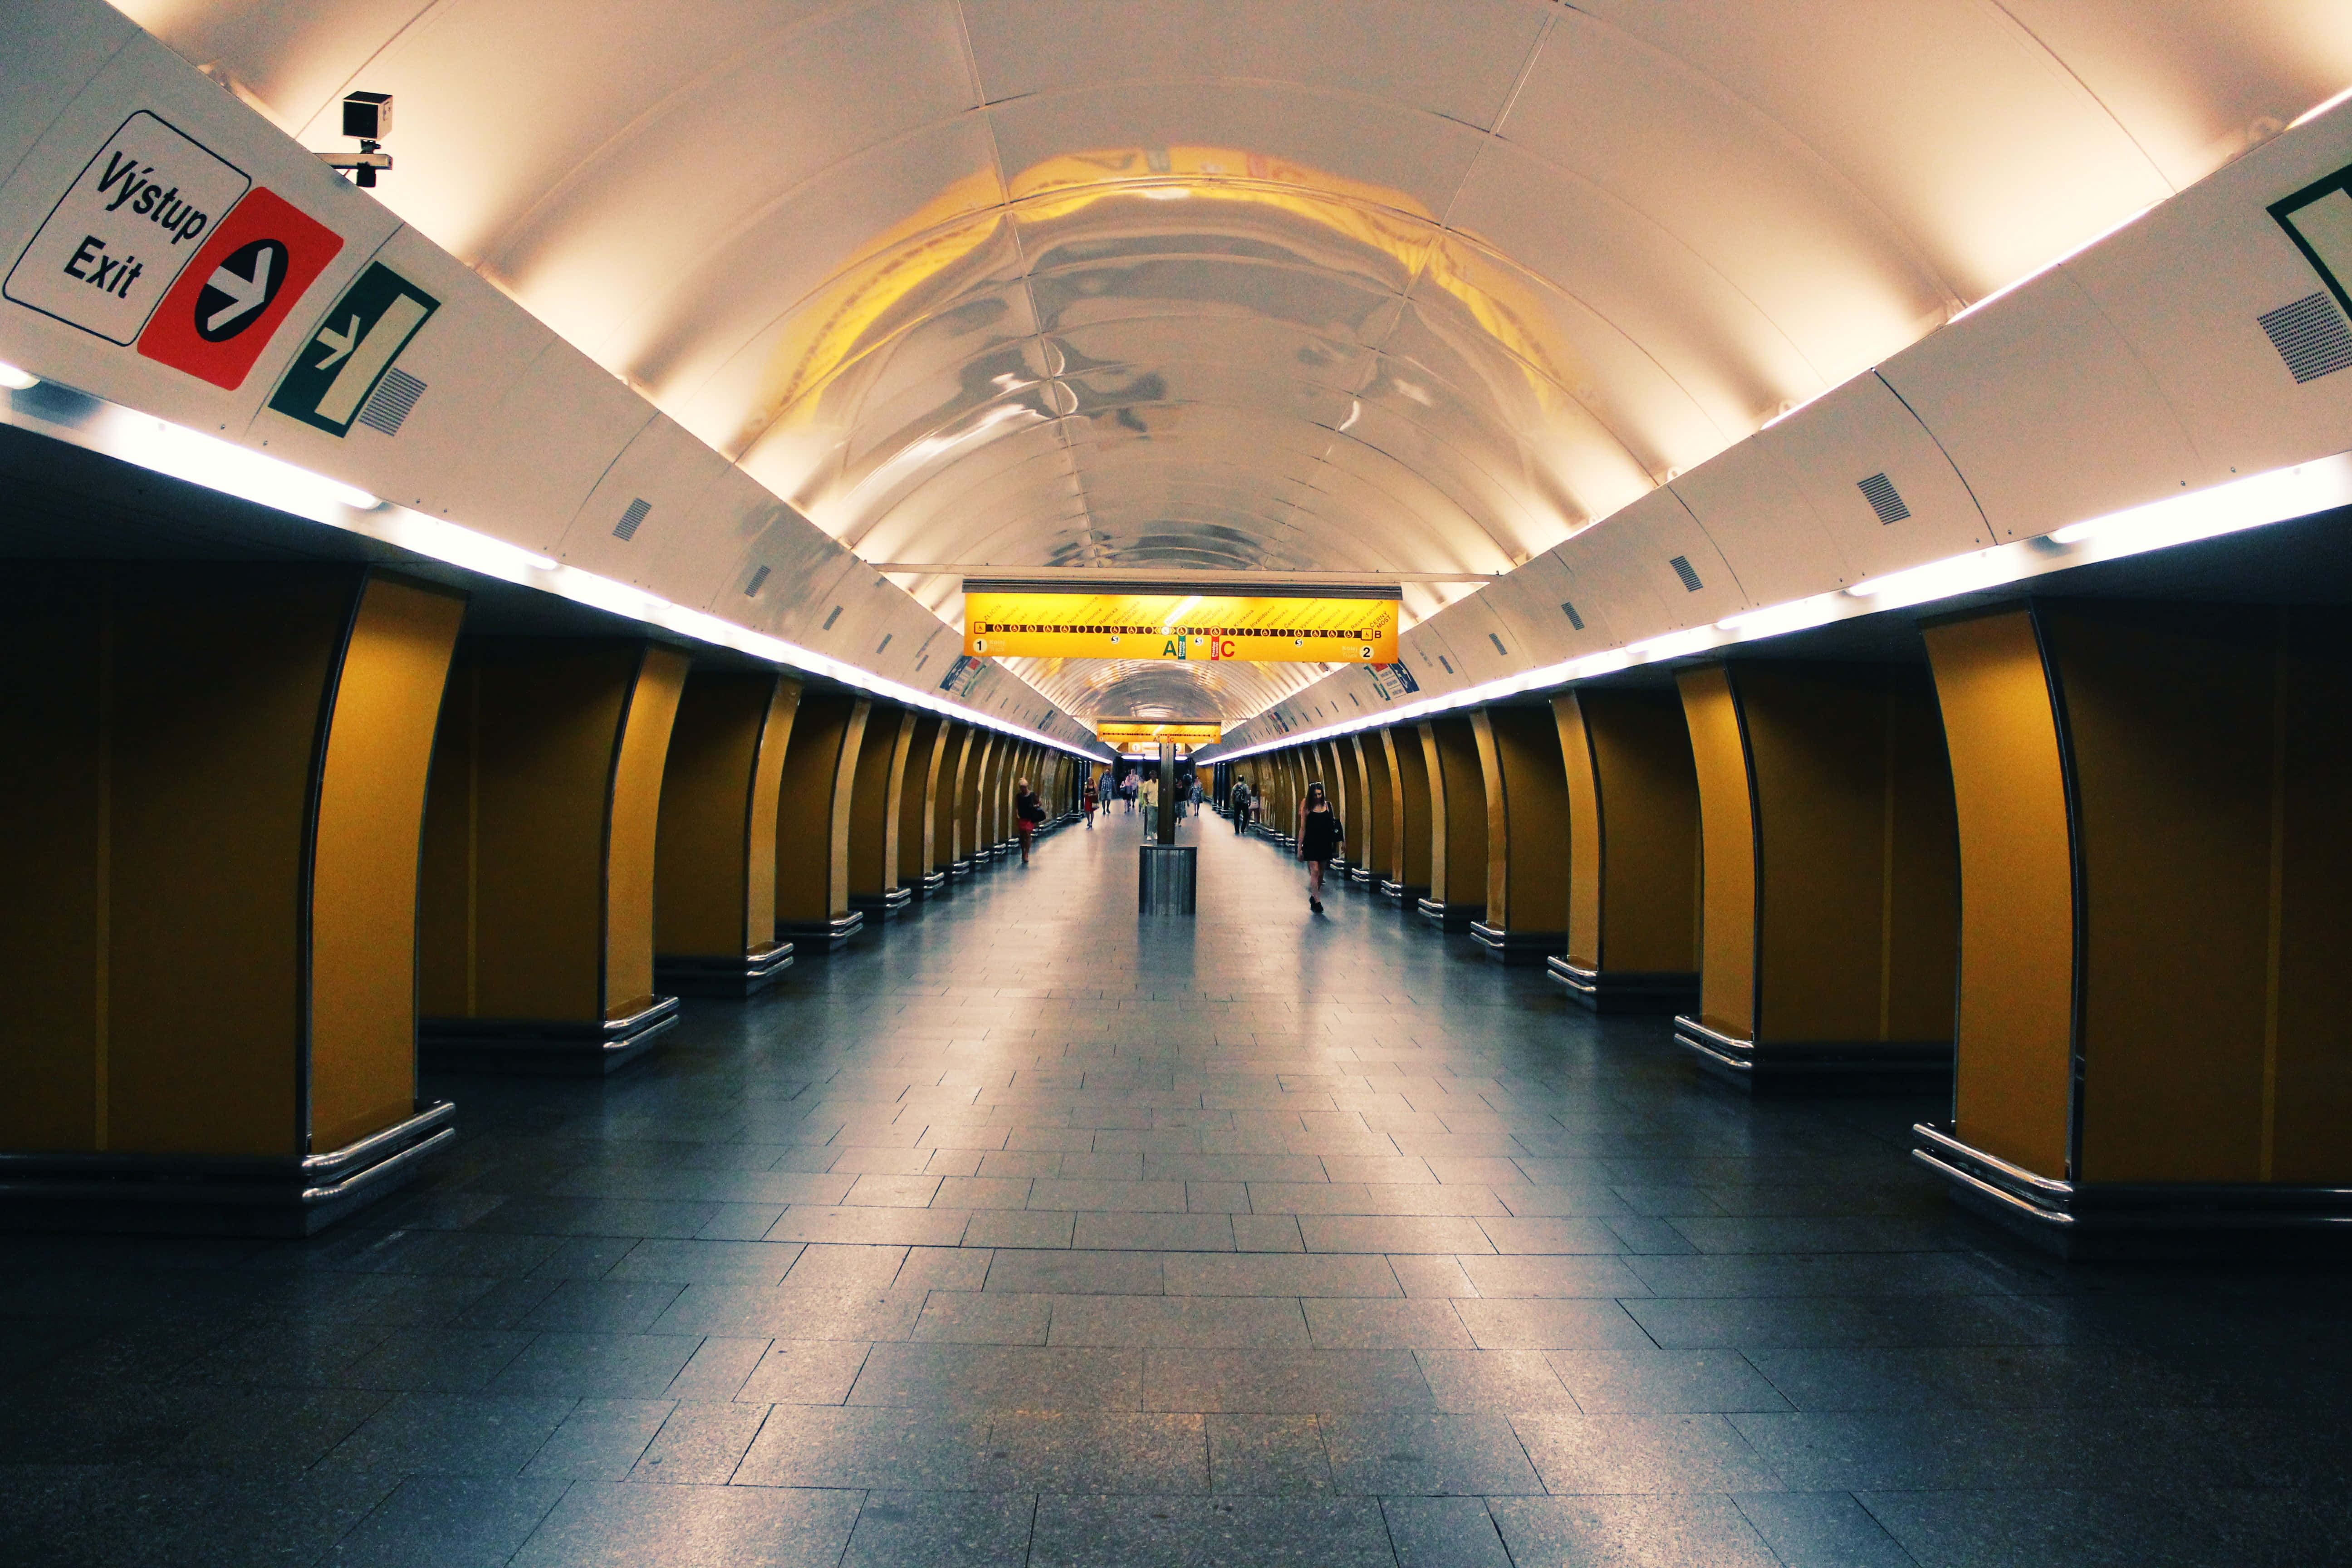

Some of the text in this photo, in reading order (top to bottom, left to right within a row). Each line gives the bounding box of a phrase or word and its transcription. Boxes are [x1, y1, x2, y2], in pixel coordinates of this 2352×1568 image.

[97, 151, 207, 245] Výstup
[64, 235, 143, 299] Exit
[1376, 614, 1392, 629] MOST
[977, 641, 981, 651] 1
[1162, 640, 1177, 657] A
[1220, 640, 1235, 658] C
[1362, 647, 1371, 658] 2
